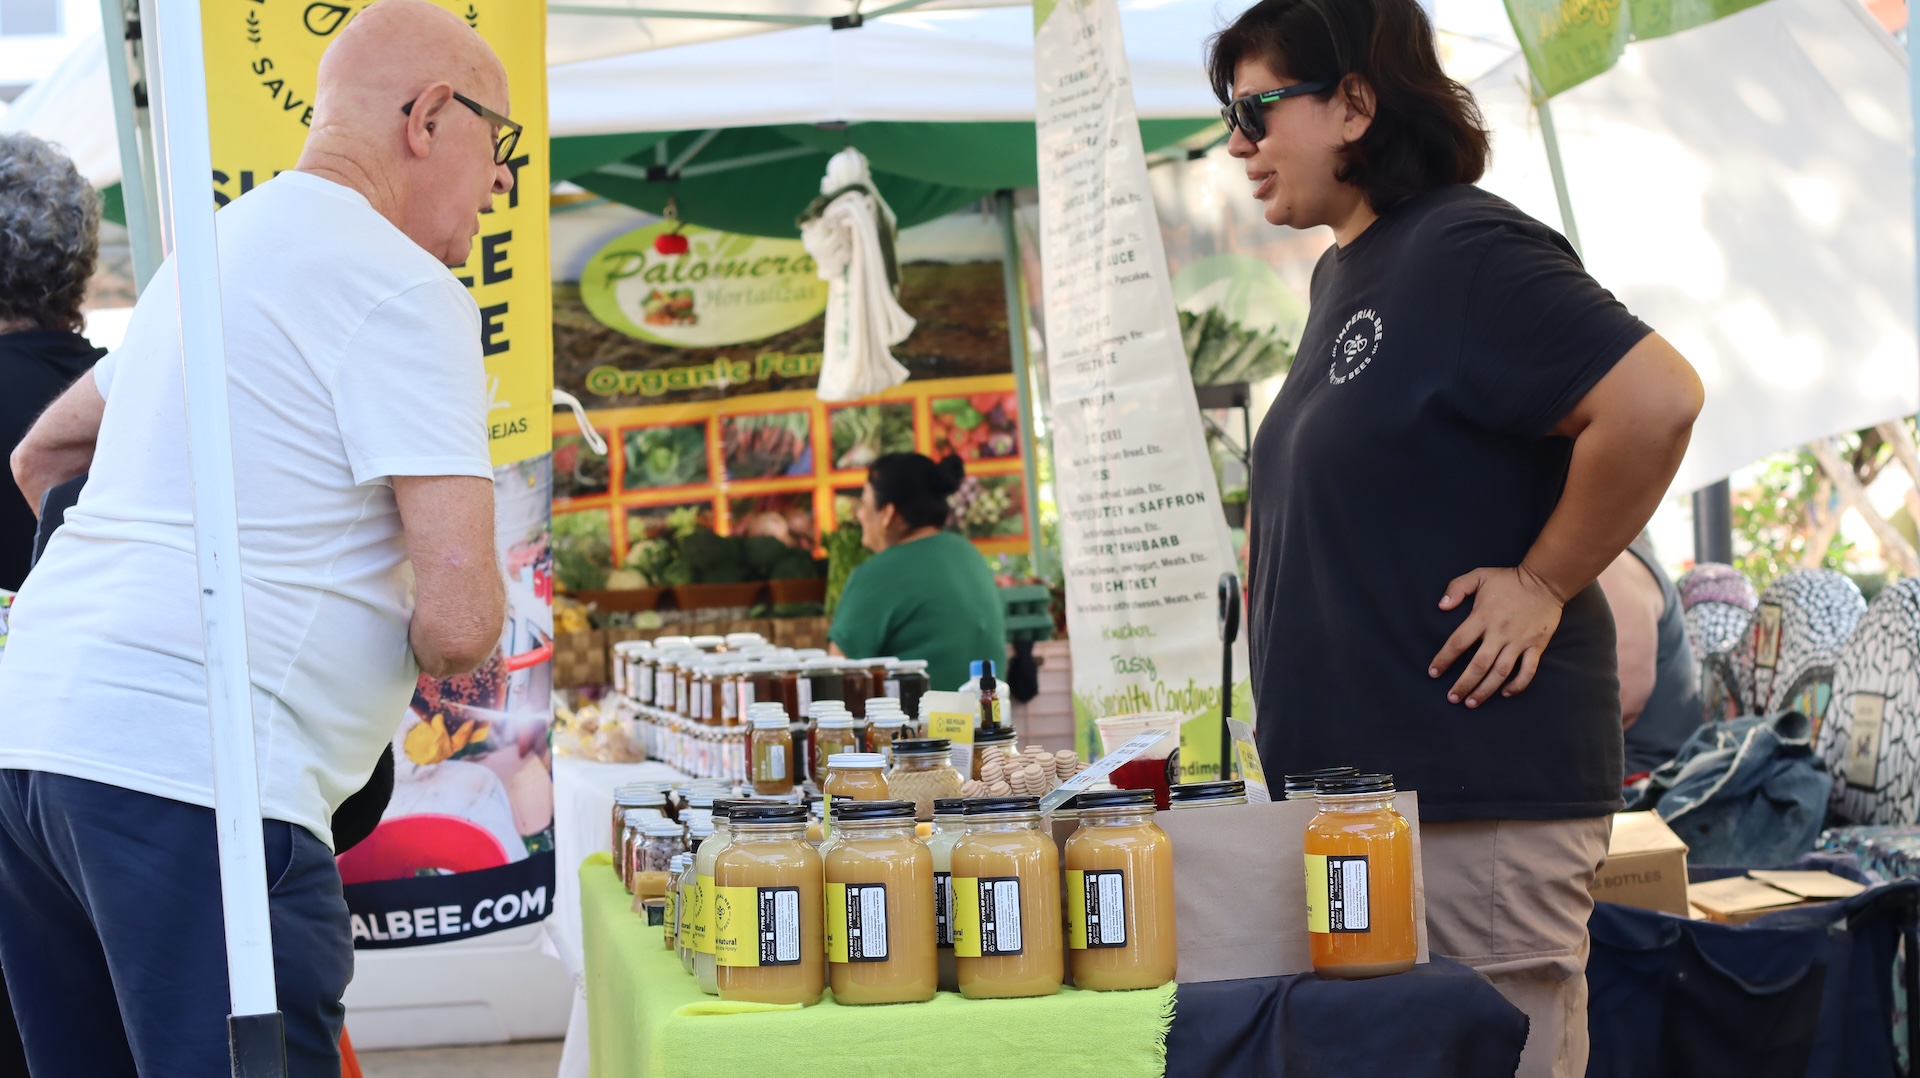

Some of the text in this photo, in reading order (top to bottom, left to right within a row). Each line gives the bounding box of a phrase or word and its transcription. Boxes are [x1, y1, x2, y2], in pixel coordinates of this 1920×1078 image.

[1335, 308, 1383, 344] IMPERIAL BEE
[590, 357, 751, 397] Organic
[1348, 356, 1372, 381] BEES
[488, 417, 528, 440] EJAS
[1140, 492, 1206, 514] SAFFRON
[1120, 534, 1180, 553] RHUBARB
[1604, 869, 1662, 888] BOTTLES
